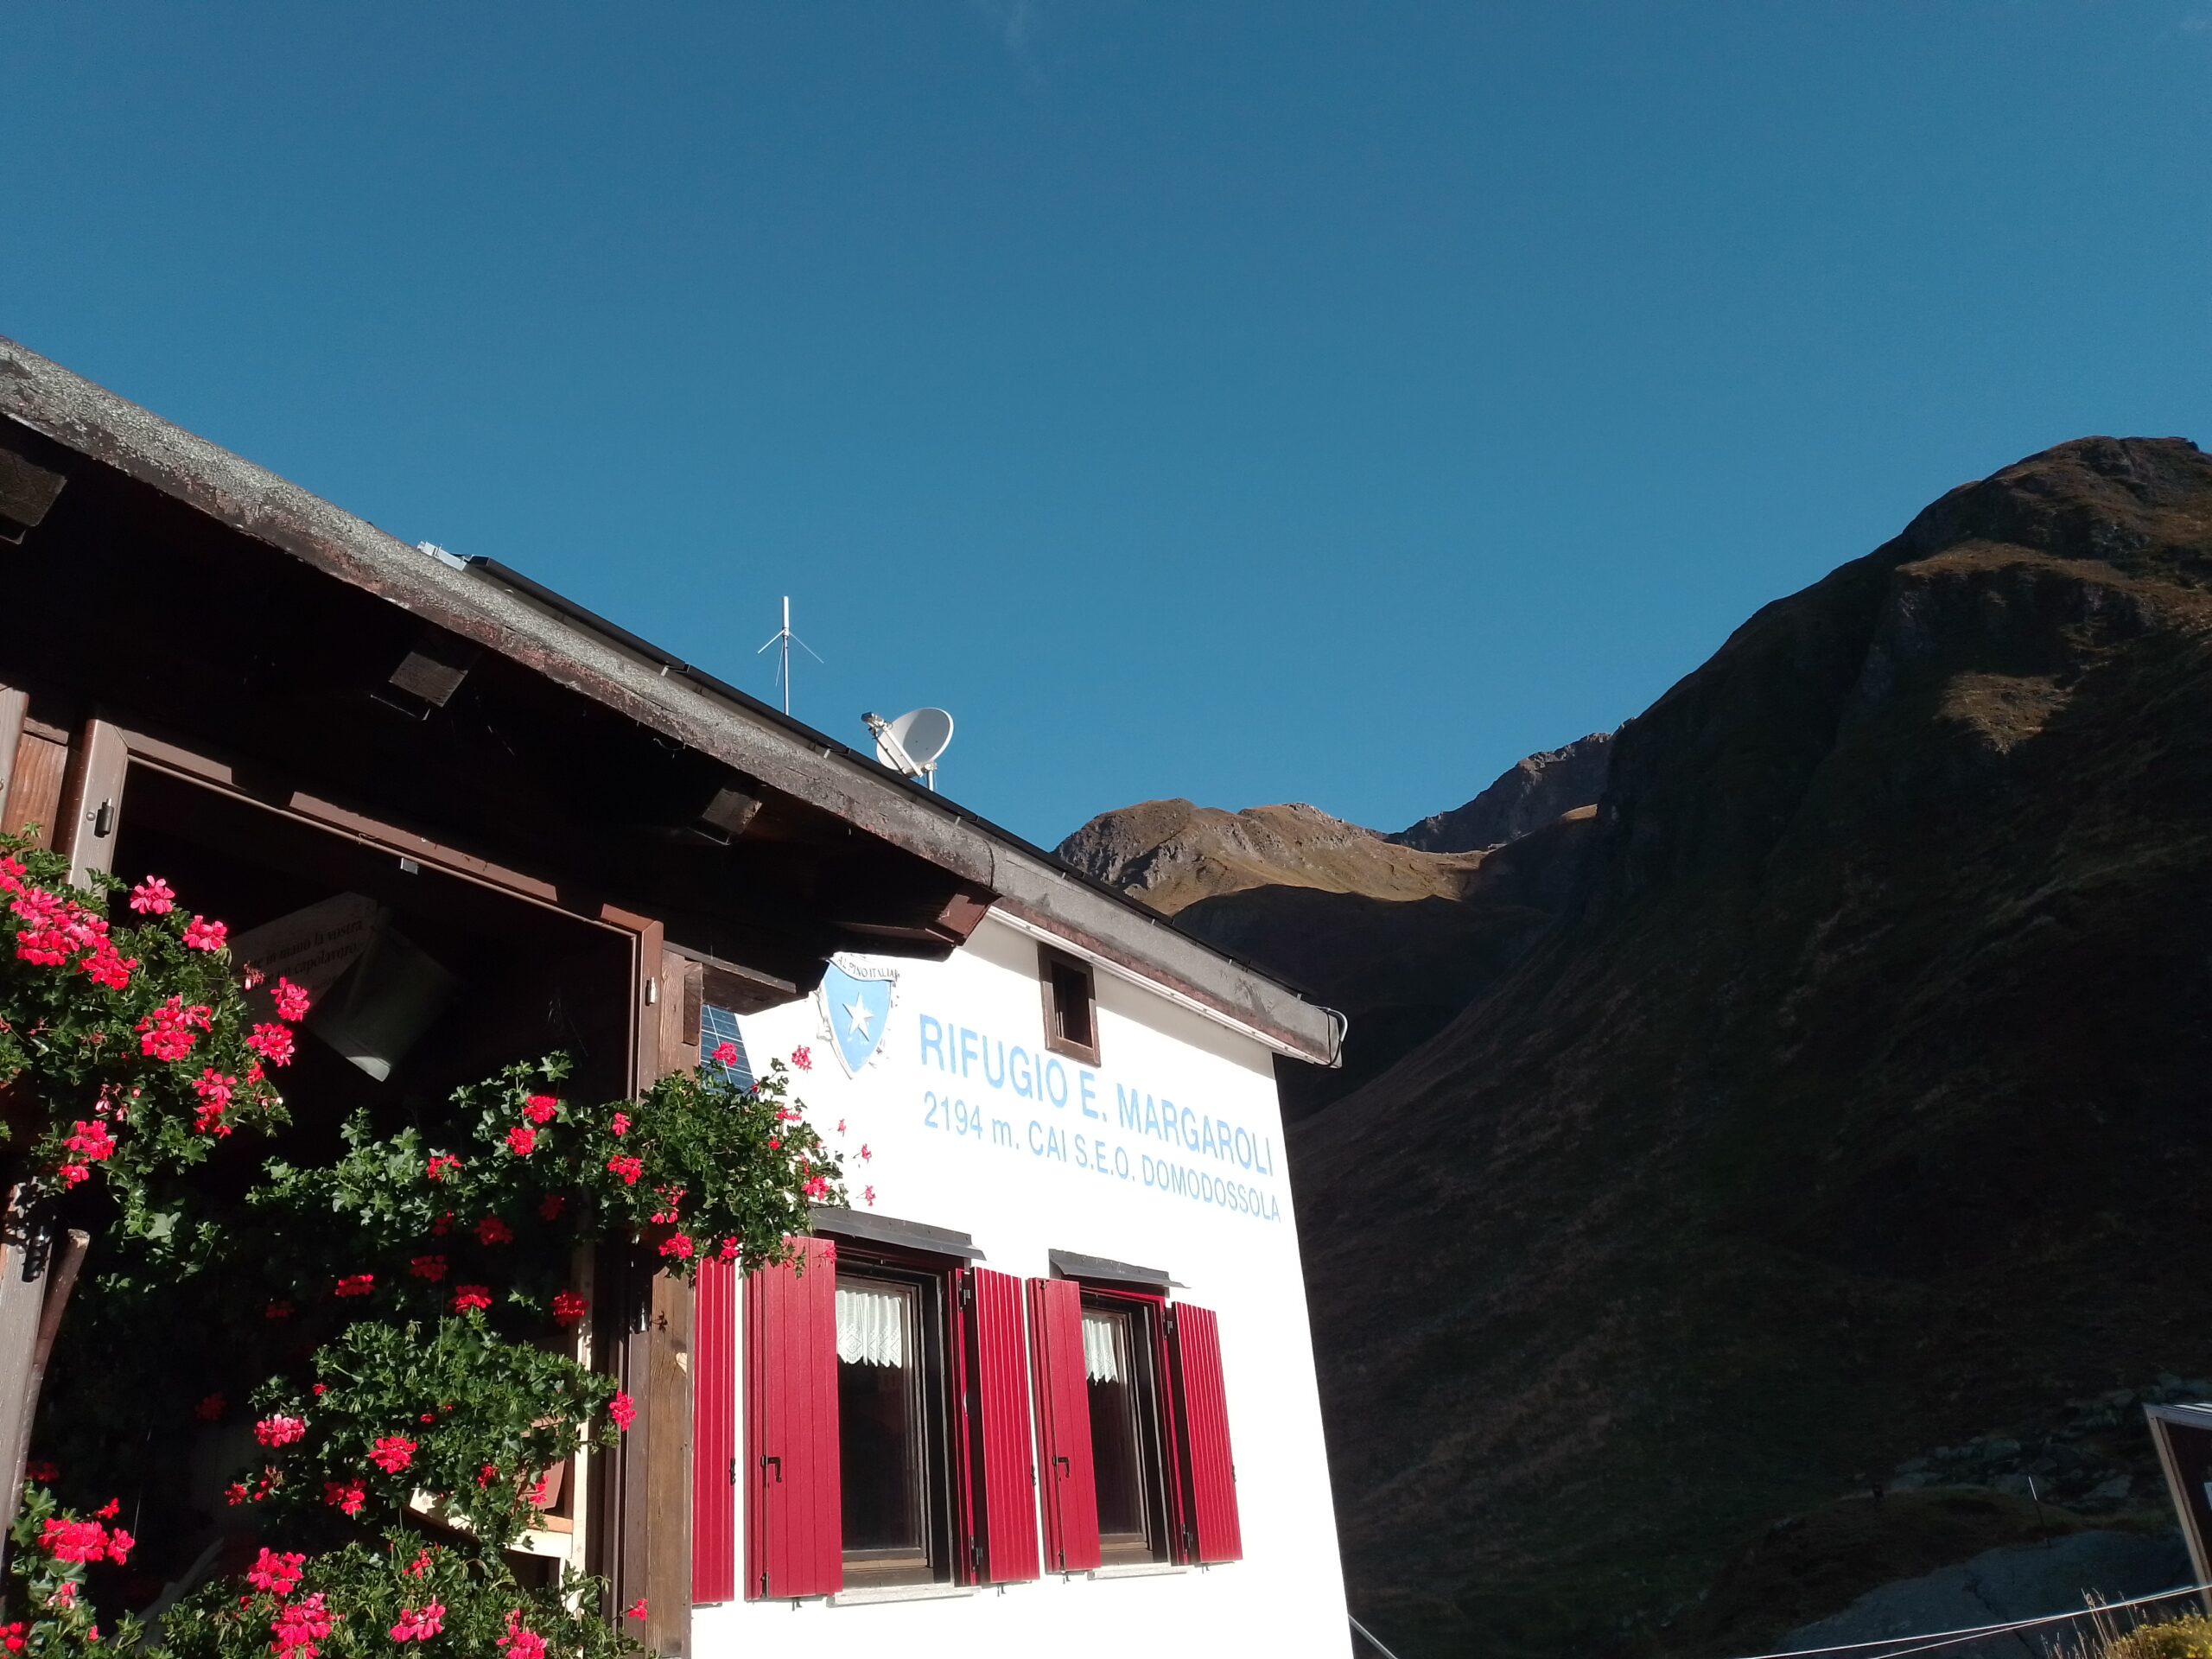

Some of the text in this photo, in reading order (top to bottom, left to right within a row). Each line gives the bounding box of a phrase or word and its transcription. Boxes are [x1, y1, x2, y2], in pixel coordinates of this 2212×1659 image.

[266, 952, 276, 966] in
[279, 939, 311, 960] mano
[314, 932, 324, 947] la
[327, 920, 363, 941] vostra
[836, 956, 868, 977] ALPINO
[919, 1014, 1273, 1177] RIFUGIO E. MARGAROLI
[924, 1090, 1281, 1224] 2194 m. CAI S.E.O. DOMODOSSOLA
